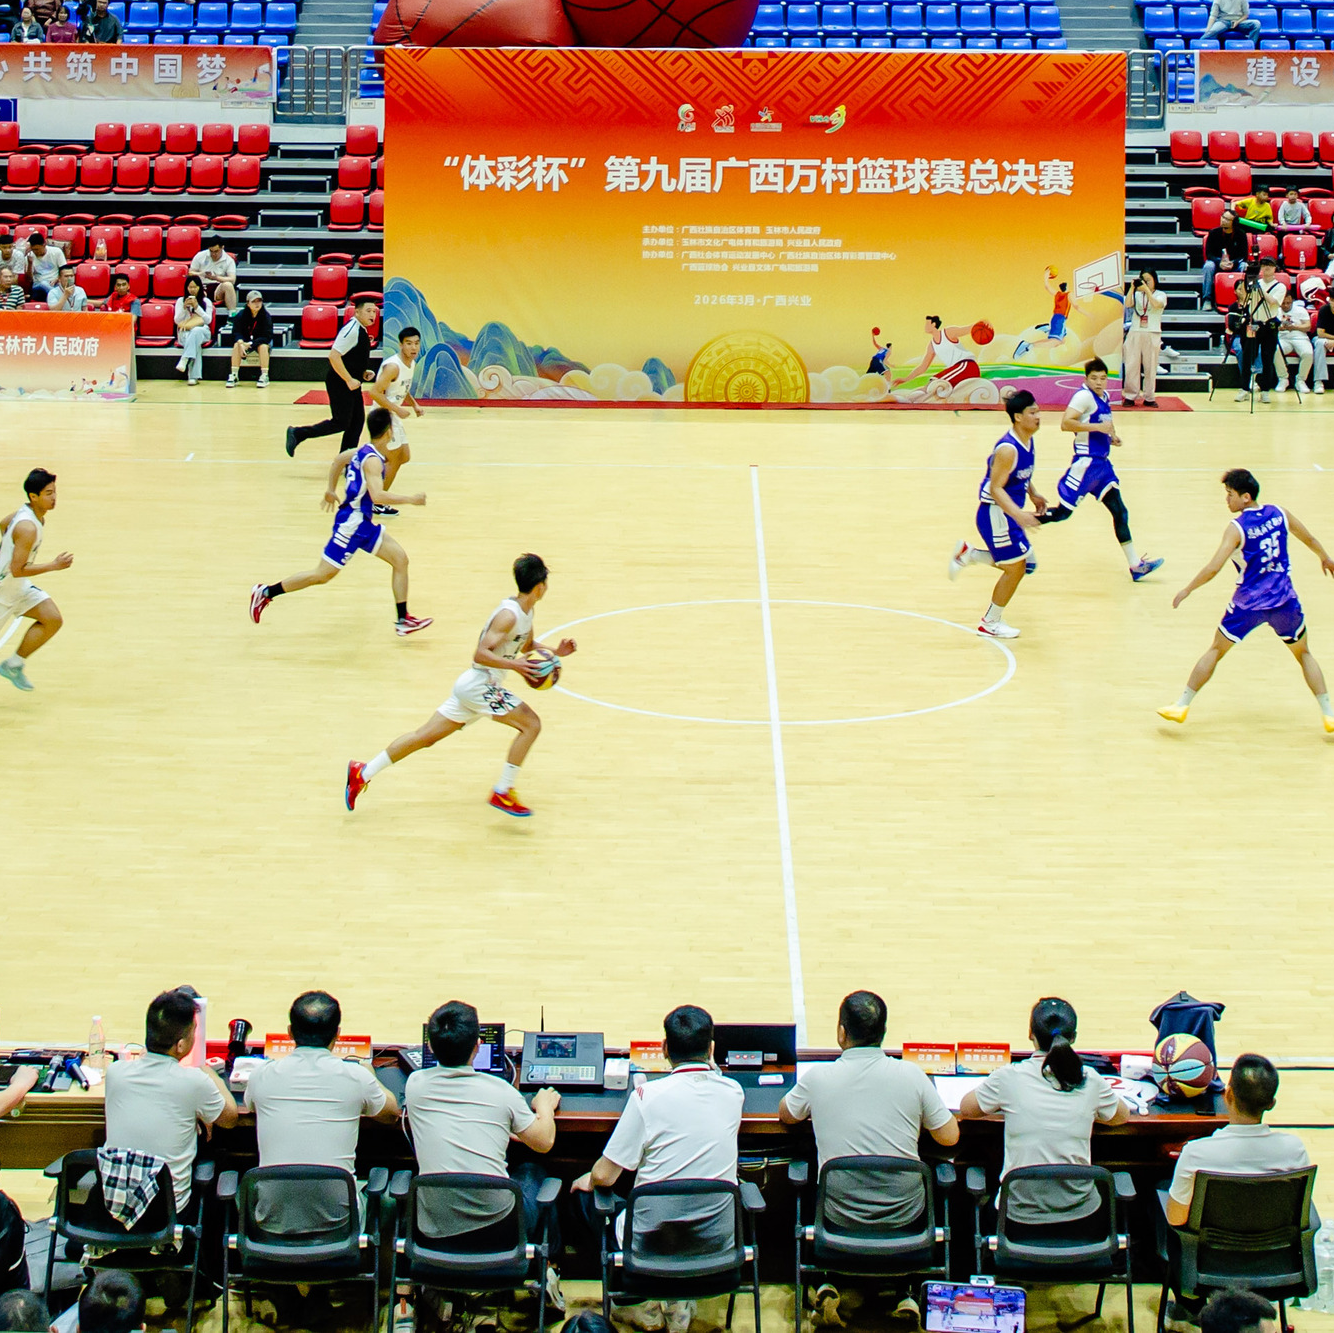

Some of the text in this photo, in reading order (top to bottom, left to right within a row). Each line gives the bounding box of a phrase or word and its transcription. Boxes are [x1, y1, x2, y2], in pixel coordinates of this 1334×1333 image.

[442, 155, 1075, 197] “体彩杯” 第九届广西万村篮球赛总决赛
